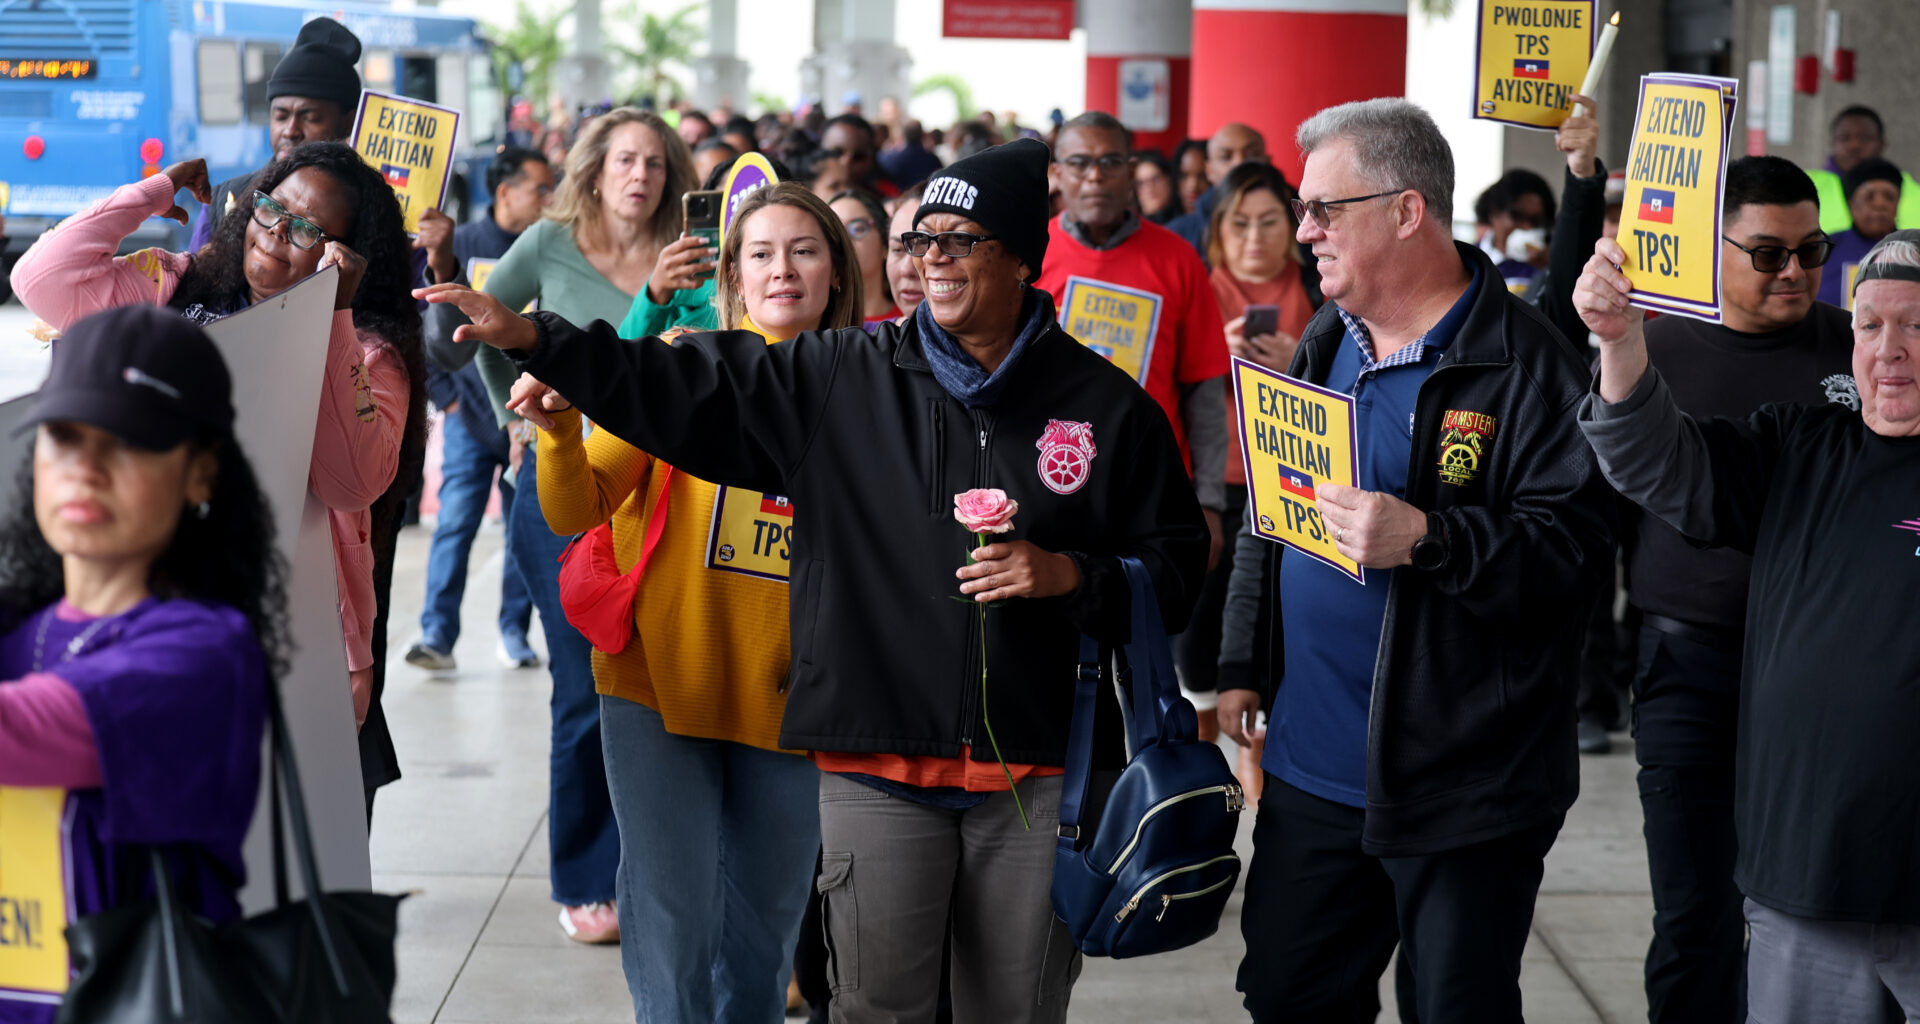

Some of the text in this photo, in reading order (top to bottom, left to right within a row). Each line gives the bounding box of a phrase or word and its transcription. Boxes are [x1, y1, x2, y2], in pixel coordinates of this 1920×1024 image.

[1493, 5, 1583, 29] PWOLONJE
[1515, 34, 1550, 55] TPS
[1492, 78, 1573, 111] AYISYEN!
[377, 106, 437, 139] EXTEND
[1647, 96, 1706, 138] EXTEND
[365, 132, 434, 169] HAITIAN
[1631, 141, 1702, 189] HAITIAN
[1633, 229, 1680, 278] TPS!
[1083, 292, 1138, 323] EXTEND
[1073, 316, 1136, 349] HAITIAN
[1257, 382, 1327, 437] EXTEND
[1441, 409, 1497, 440] TEAMSTERS
[1254, 418, 1332, 480] HAITIAN
[1443, 465, 1472, 476] LOCAL
[1279, 496, 1330, 545] TPS!
